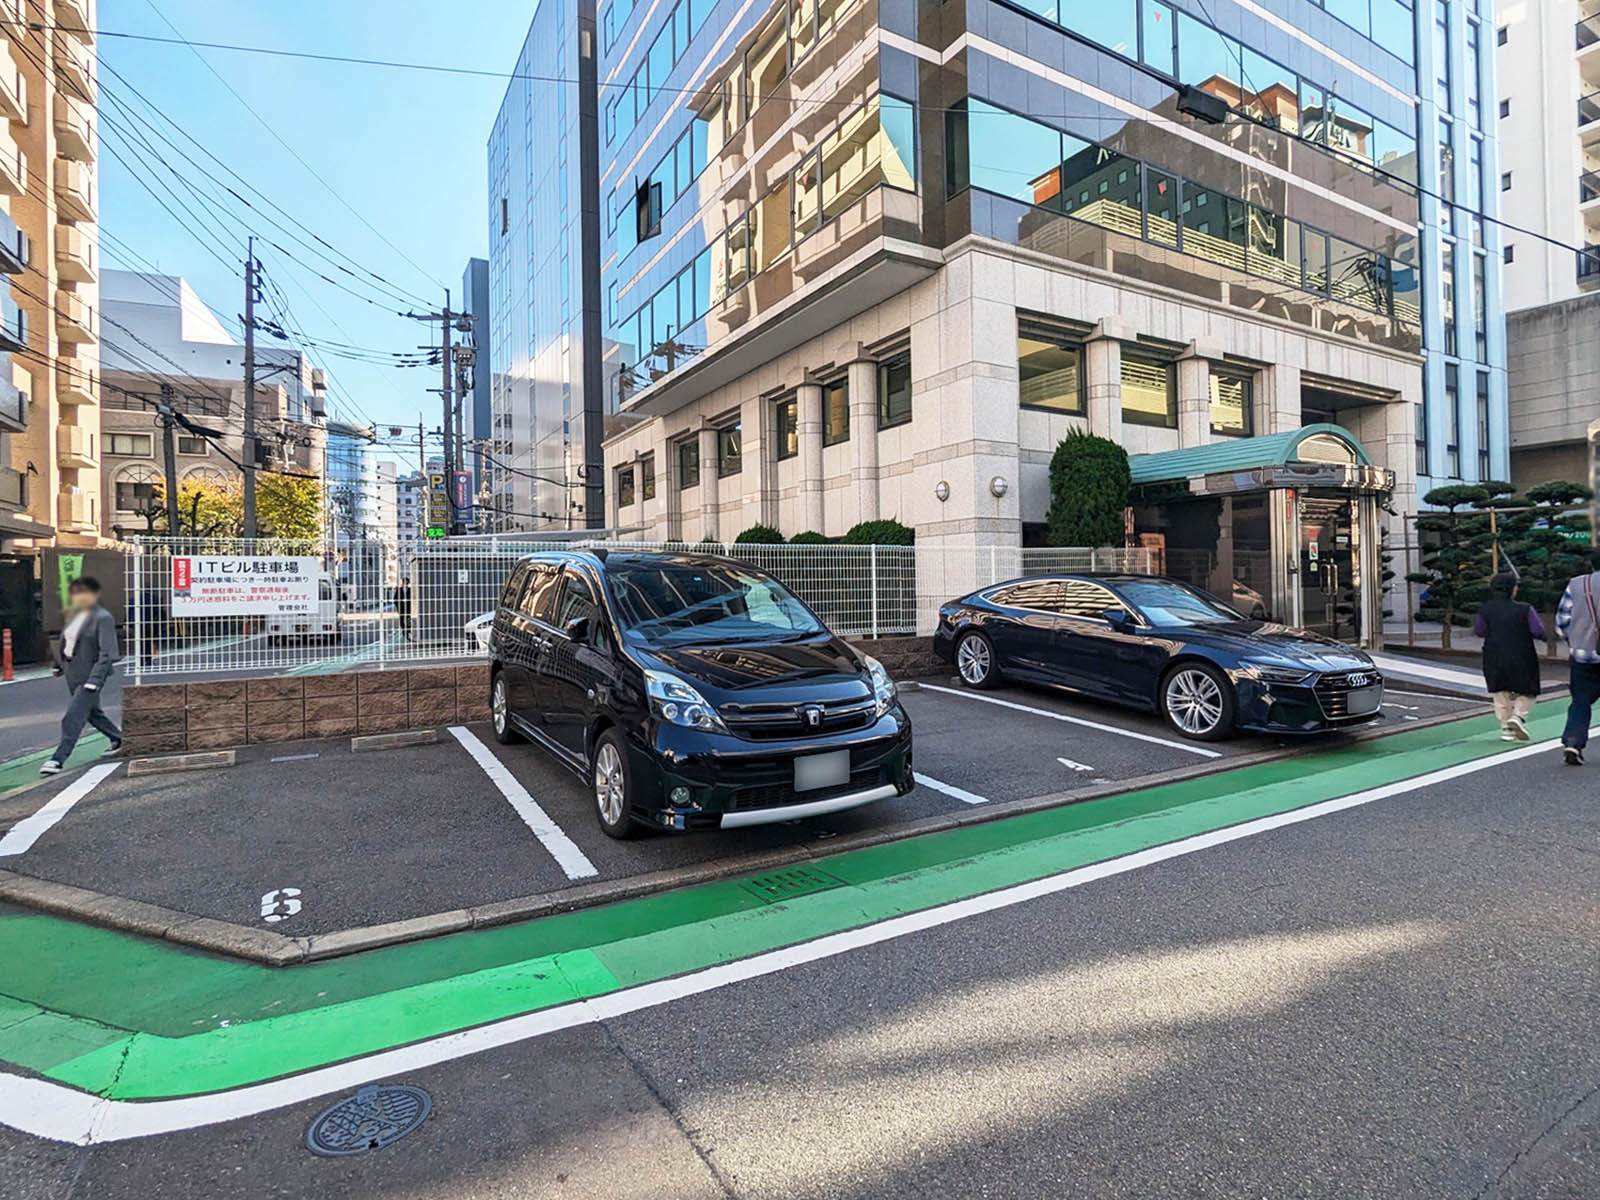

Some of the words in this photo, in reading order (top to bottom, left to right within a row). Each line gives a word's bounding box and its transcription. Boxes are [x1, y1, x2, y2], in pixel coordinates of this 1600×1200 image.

[431, 474, 444, 488] P
[199, 561, 298, 574] ITビル駐車場
[261, 888, 302, 922] 6
